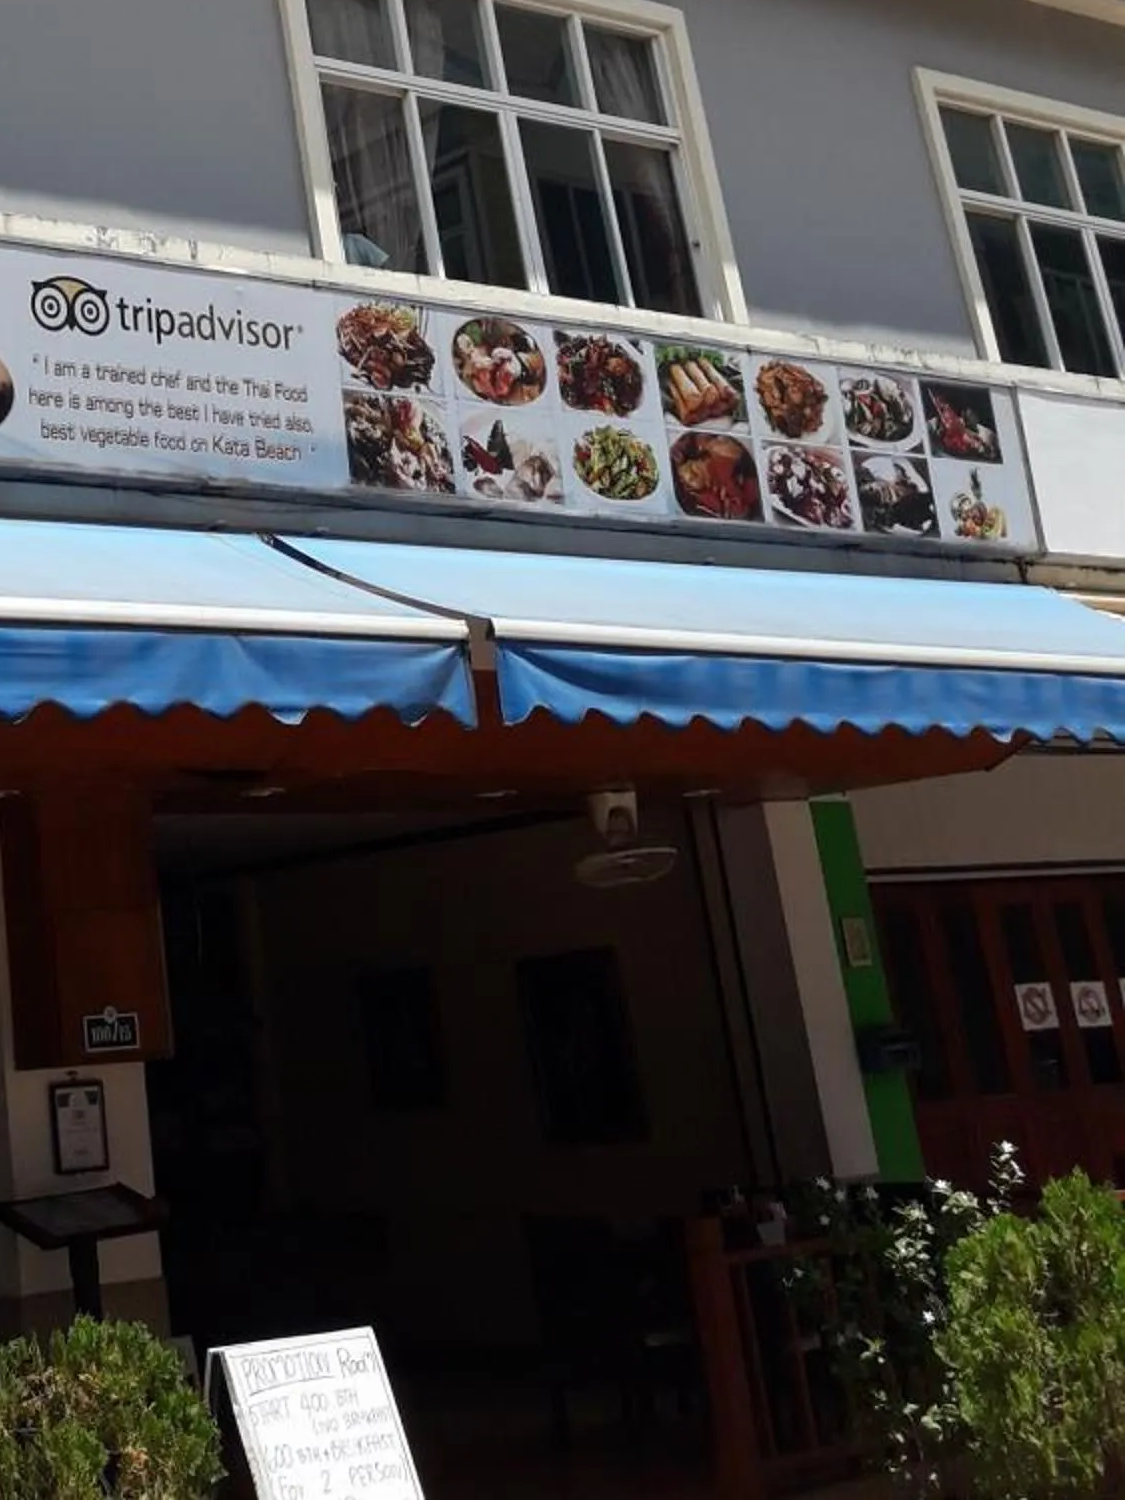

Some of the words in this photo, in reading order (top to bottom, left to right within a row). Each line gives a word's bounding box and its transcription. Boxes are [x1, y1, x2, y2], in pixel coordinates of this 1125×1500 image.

[116, 297, 295, 350] tripadvisor
[54, 361, 76, 378] am
[81, 364, 91, 379] a
[95, 363, 146, 385] trained
[150, 366, 182, 389] chef
[186, 372, 211, 393] and
[215, 375, 239, 395] the
[242, 379, 269, 399] Thai
[274, 382, 308, 403] Food
[28, 387, 64, 408] here
[69, 387, 81, 409] is
[86, 396, 134, 418] among
[138, 396, 163, 418] the
[167, 399, 200, 421] best
[212, 404, 245, 426] have
[248, 409, 280, 429] tried
[39, 418, 76, 441] best
[80, 425, 150, 449] vegetable
[154, 430, 186, 451] food
[190, 437, 208, 453] on
[212, 435, 250, 457] Kata
[254, 436, 302, 461] Beach
